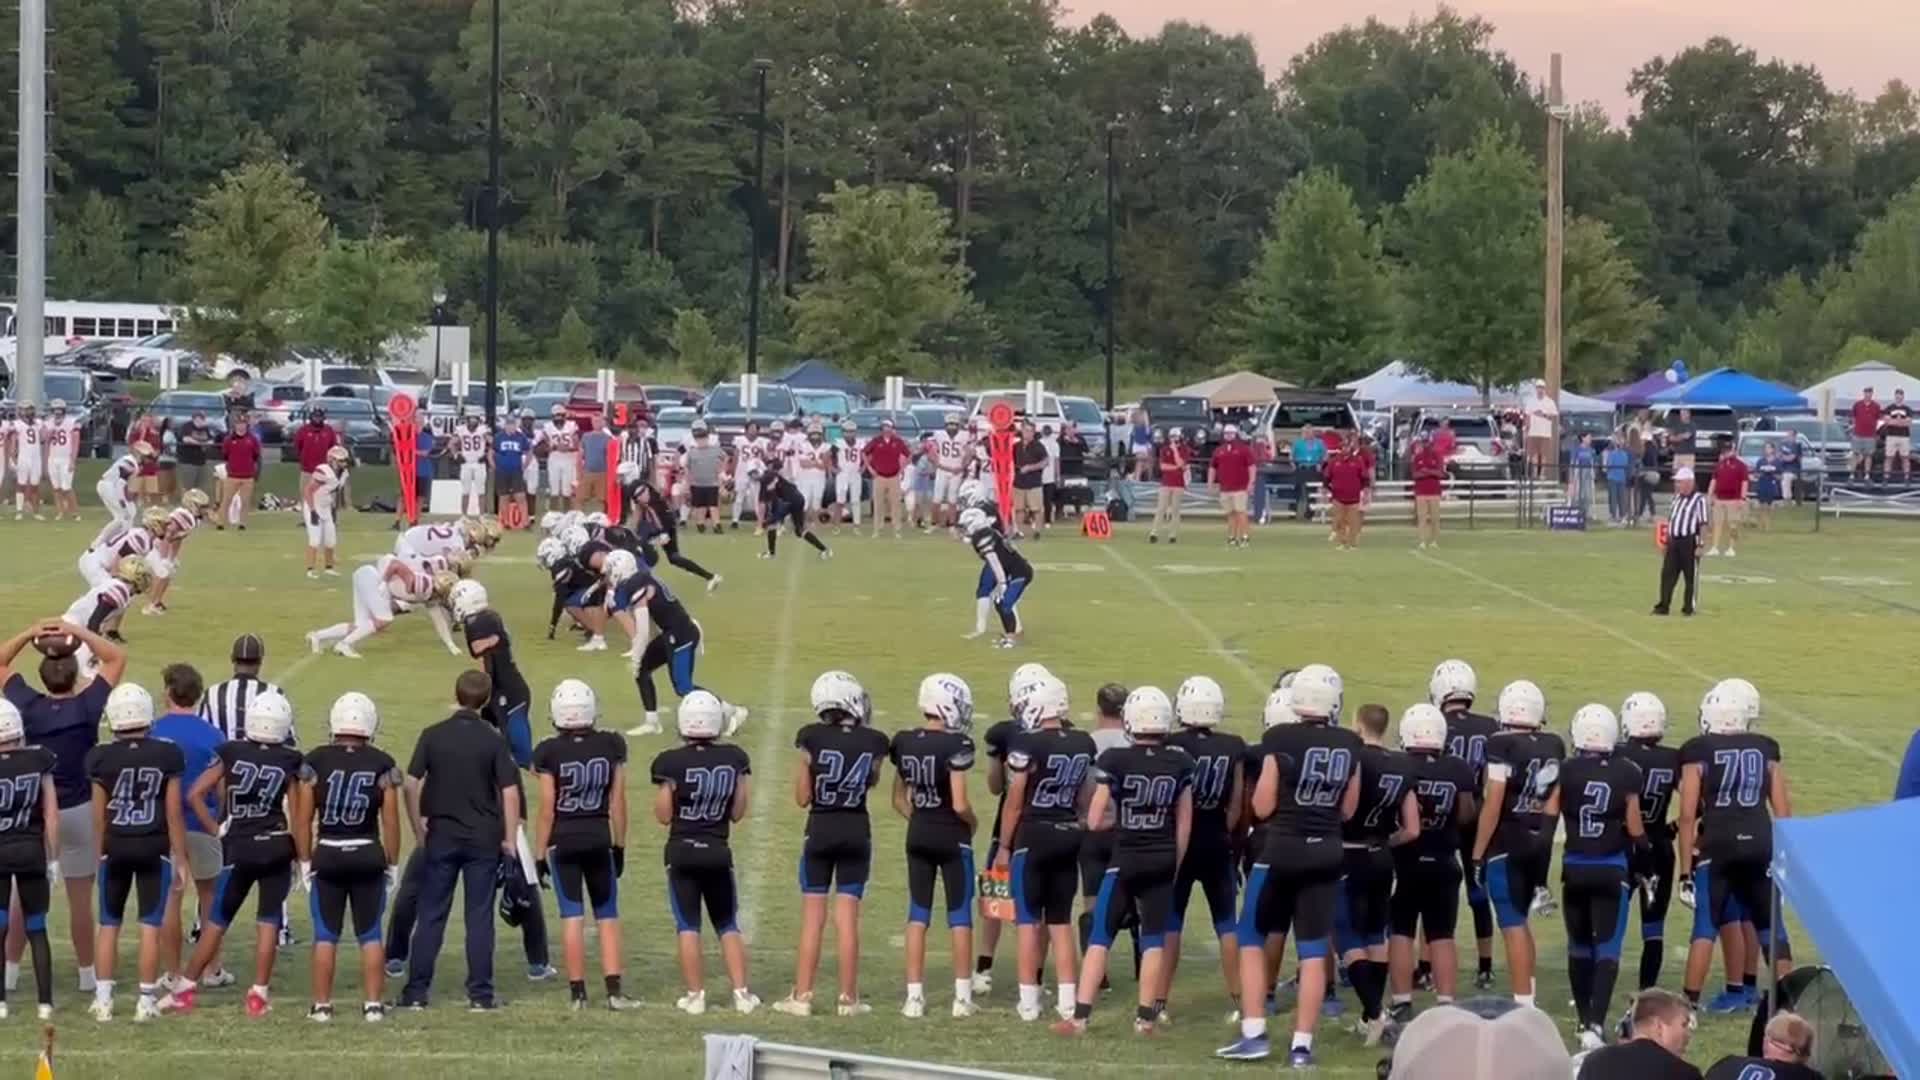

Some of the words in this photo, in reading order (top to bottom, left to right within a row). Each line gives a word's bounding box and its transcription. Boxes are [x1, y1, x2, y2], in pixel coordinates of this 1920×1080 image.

[26, 428, 36, 444] 9
[941, 441, 960, 458] 65
[1089, 513, 1109, 534] 40
[106, 766, 164, 827] 43
[227, 759, 286, 818] 23
[322, 769, 376, 827] 16
[557, 756, 610, 812] 20
[680, 764, 737, 822] 30
[815, 750, 874, 808] 24
[901, 754, 942, 809] 21
[1295, 747, 1351, 806] 69
[1364, 773, 1404, 828] 7
[1714, 748, 1764, 808] 78
[1579, 780, 1612, 838] 2
